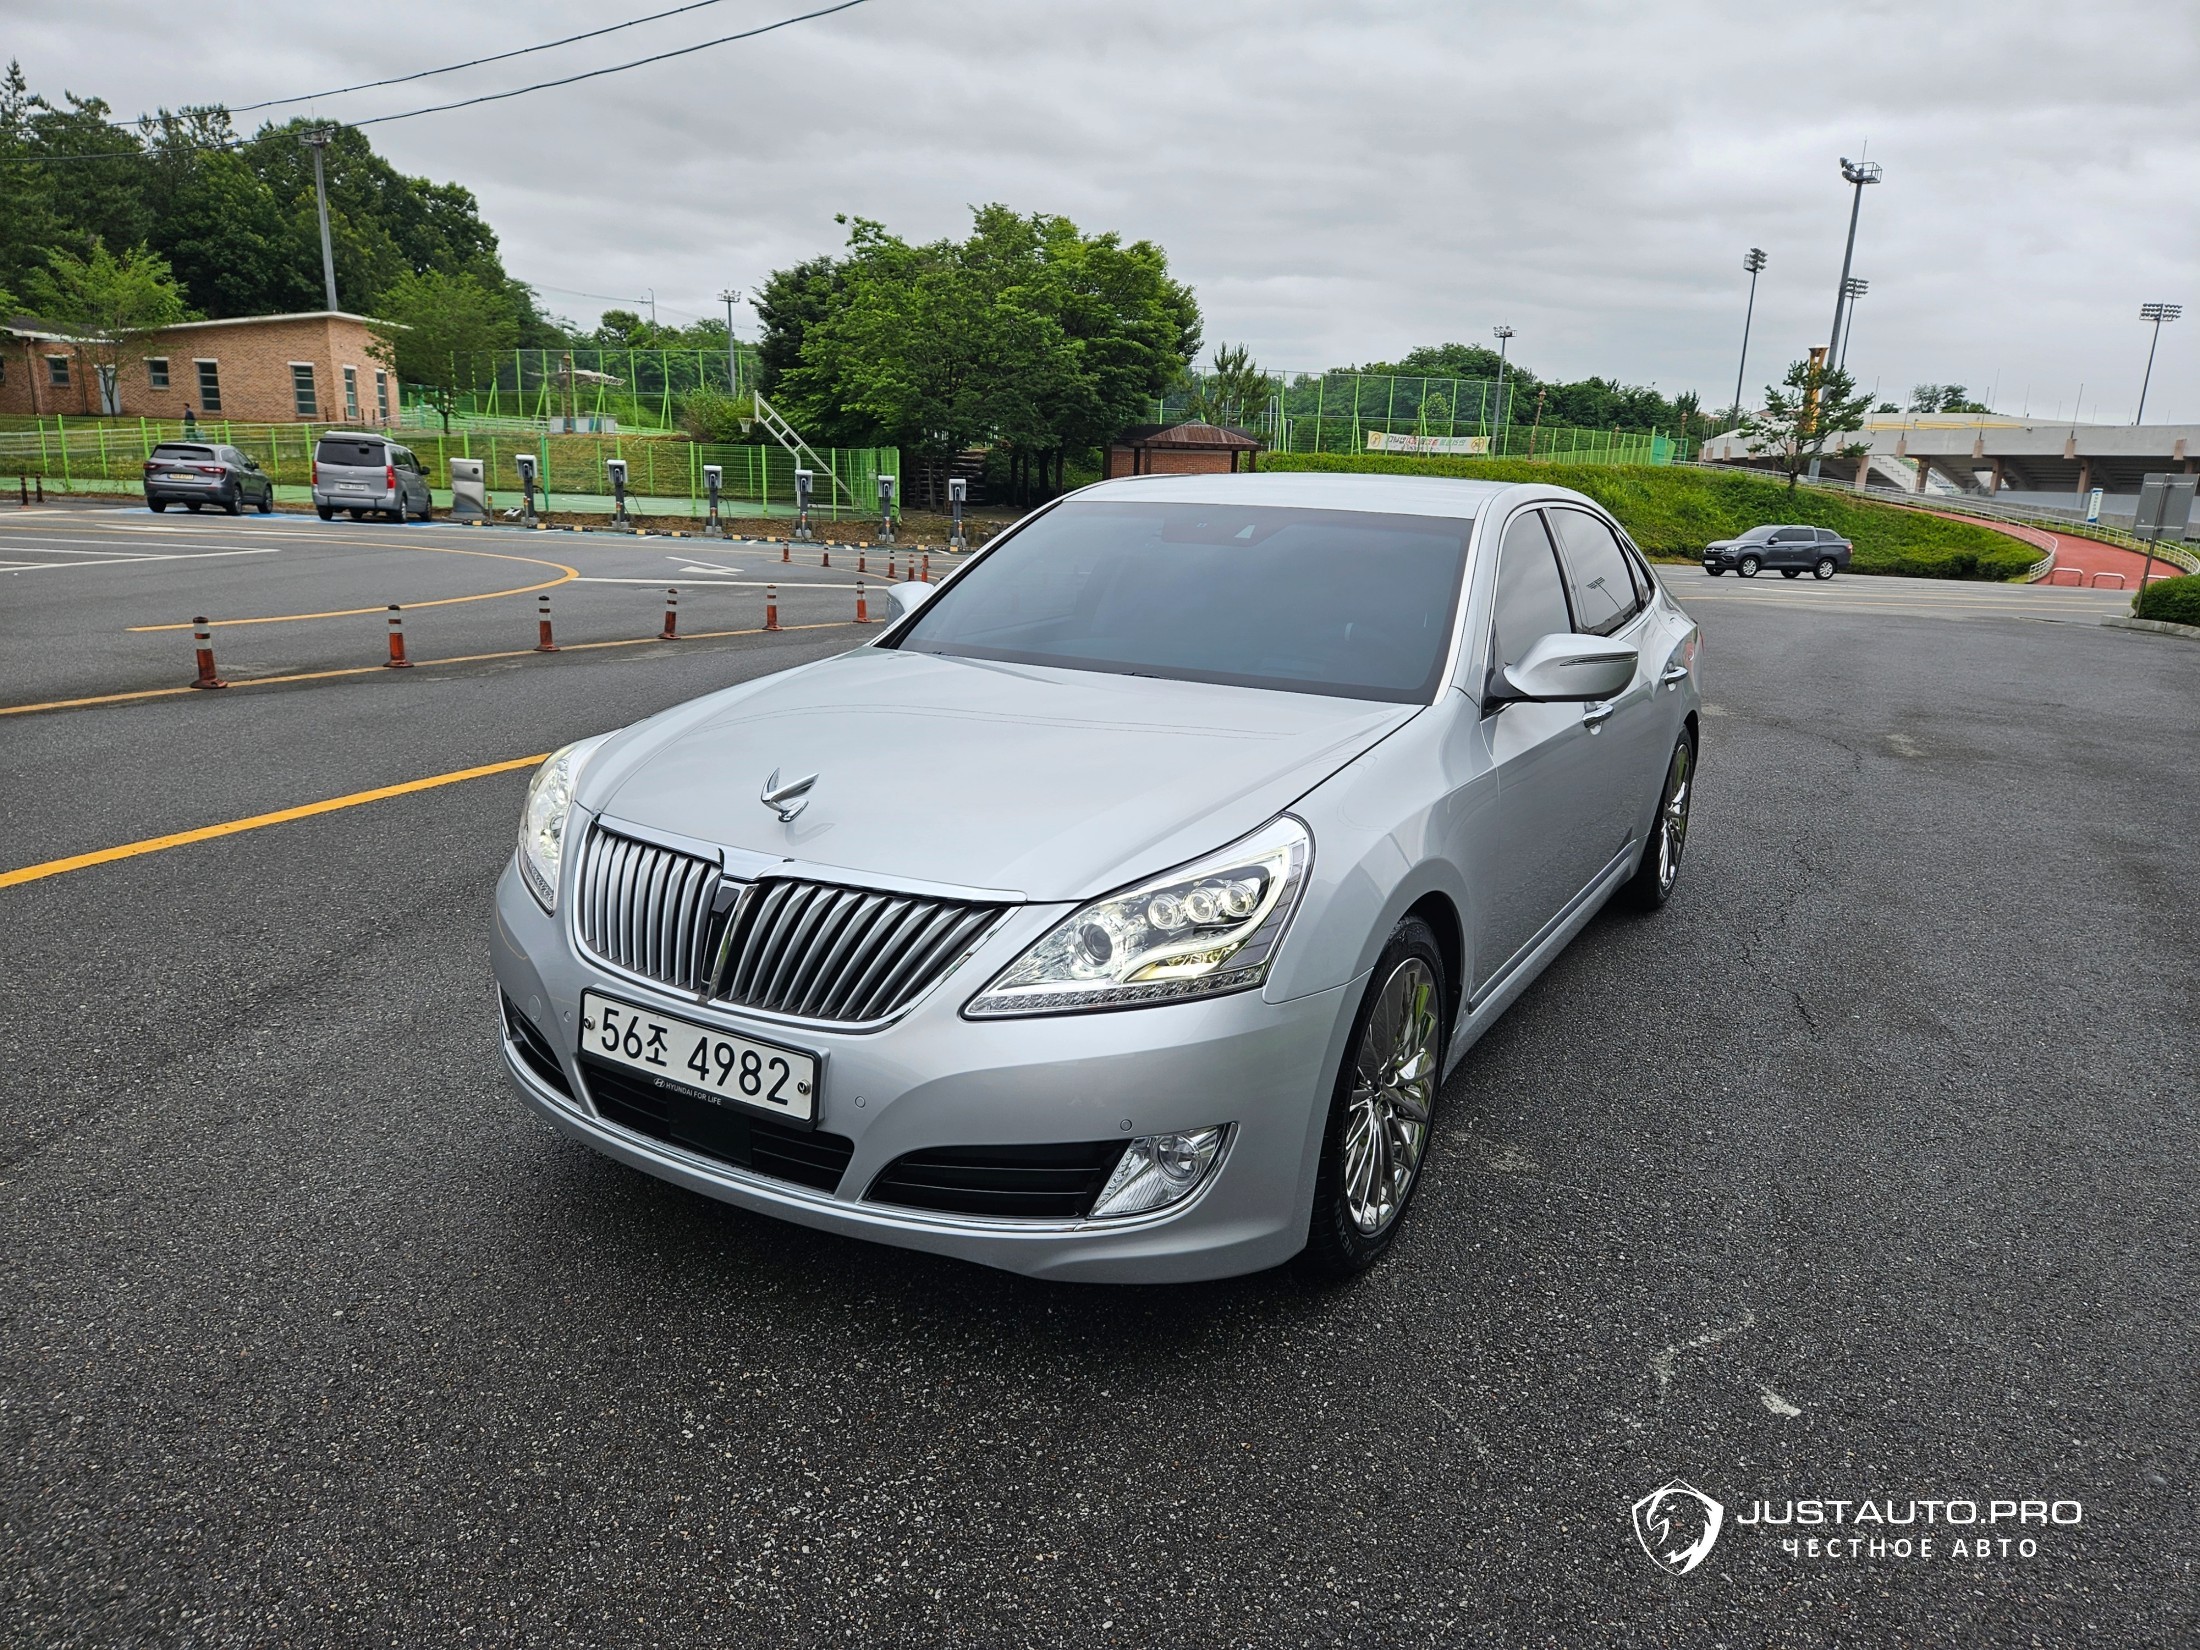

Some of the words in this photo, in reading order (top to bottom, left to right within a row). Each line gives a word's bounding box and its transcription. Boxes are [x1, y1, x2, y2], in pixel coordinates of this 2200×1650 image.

[601, 1007, 668, 1067] 56조
[687, 1036, 790, 1106] 4982
[665, 1082, 693, 1097] HYUNDAI
[693, 1090, 707, 1100] FOR
[707, 1094, 722, 1106] LIFE
